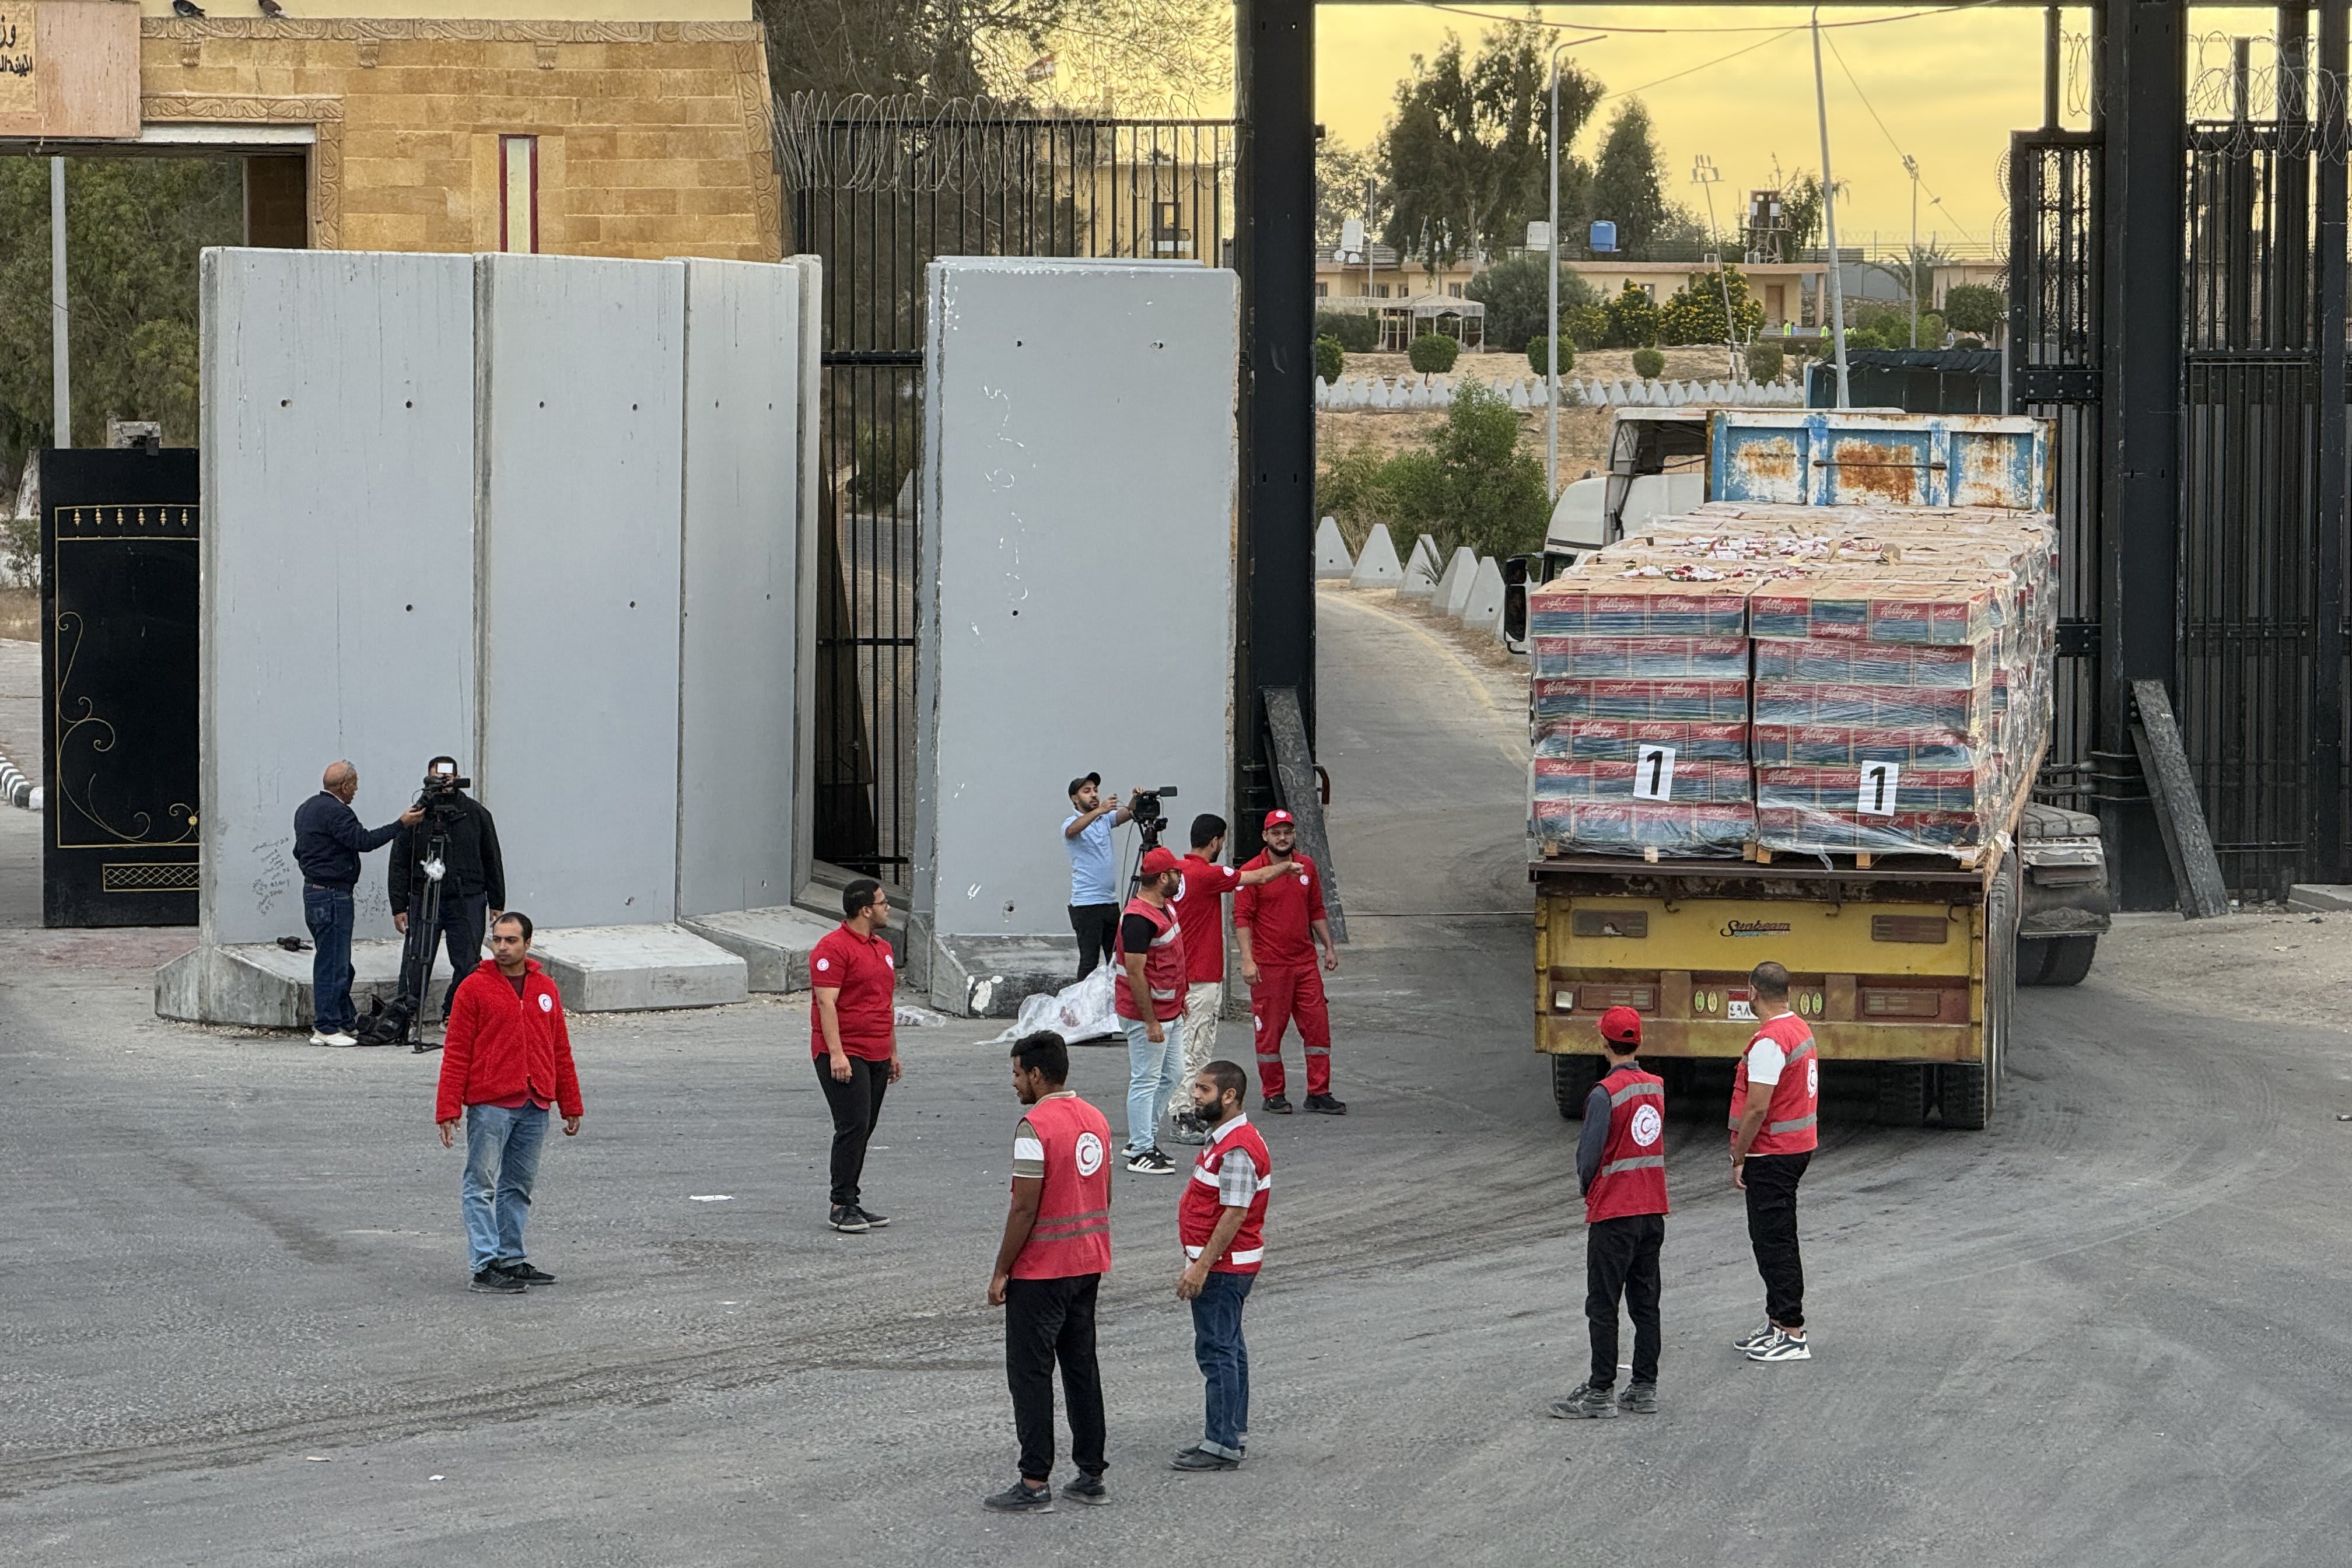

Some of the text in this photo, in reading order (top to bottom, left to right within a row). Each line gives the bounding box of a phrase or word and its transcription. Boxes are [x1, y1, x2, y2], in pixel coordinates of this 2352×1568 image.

[1759, 598, 1798, 614] Kellogg's
[1880, 603, 1920, 620] Kellogg's
[1544, 682, 1582, 699] Kellogg's
[1580, 723, 1618, 737] Kellogg's
[1639, 723, 1677, 738] Kellogg's
[1801, 729, 1839, 744] Kellogg's
[1647, 751, 1663, 795] 1
[1768, 771, 1805, 785] Kellogg's
[1870, 766, 1885, 811] 1
